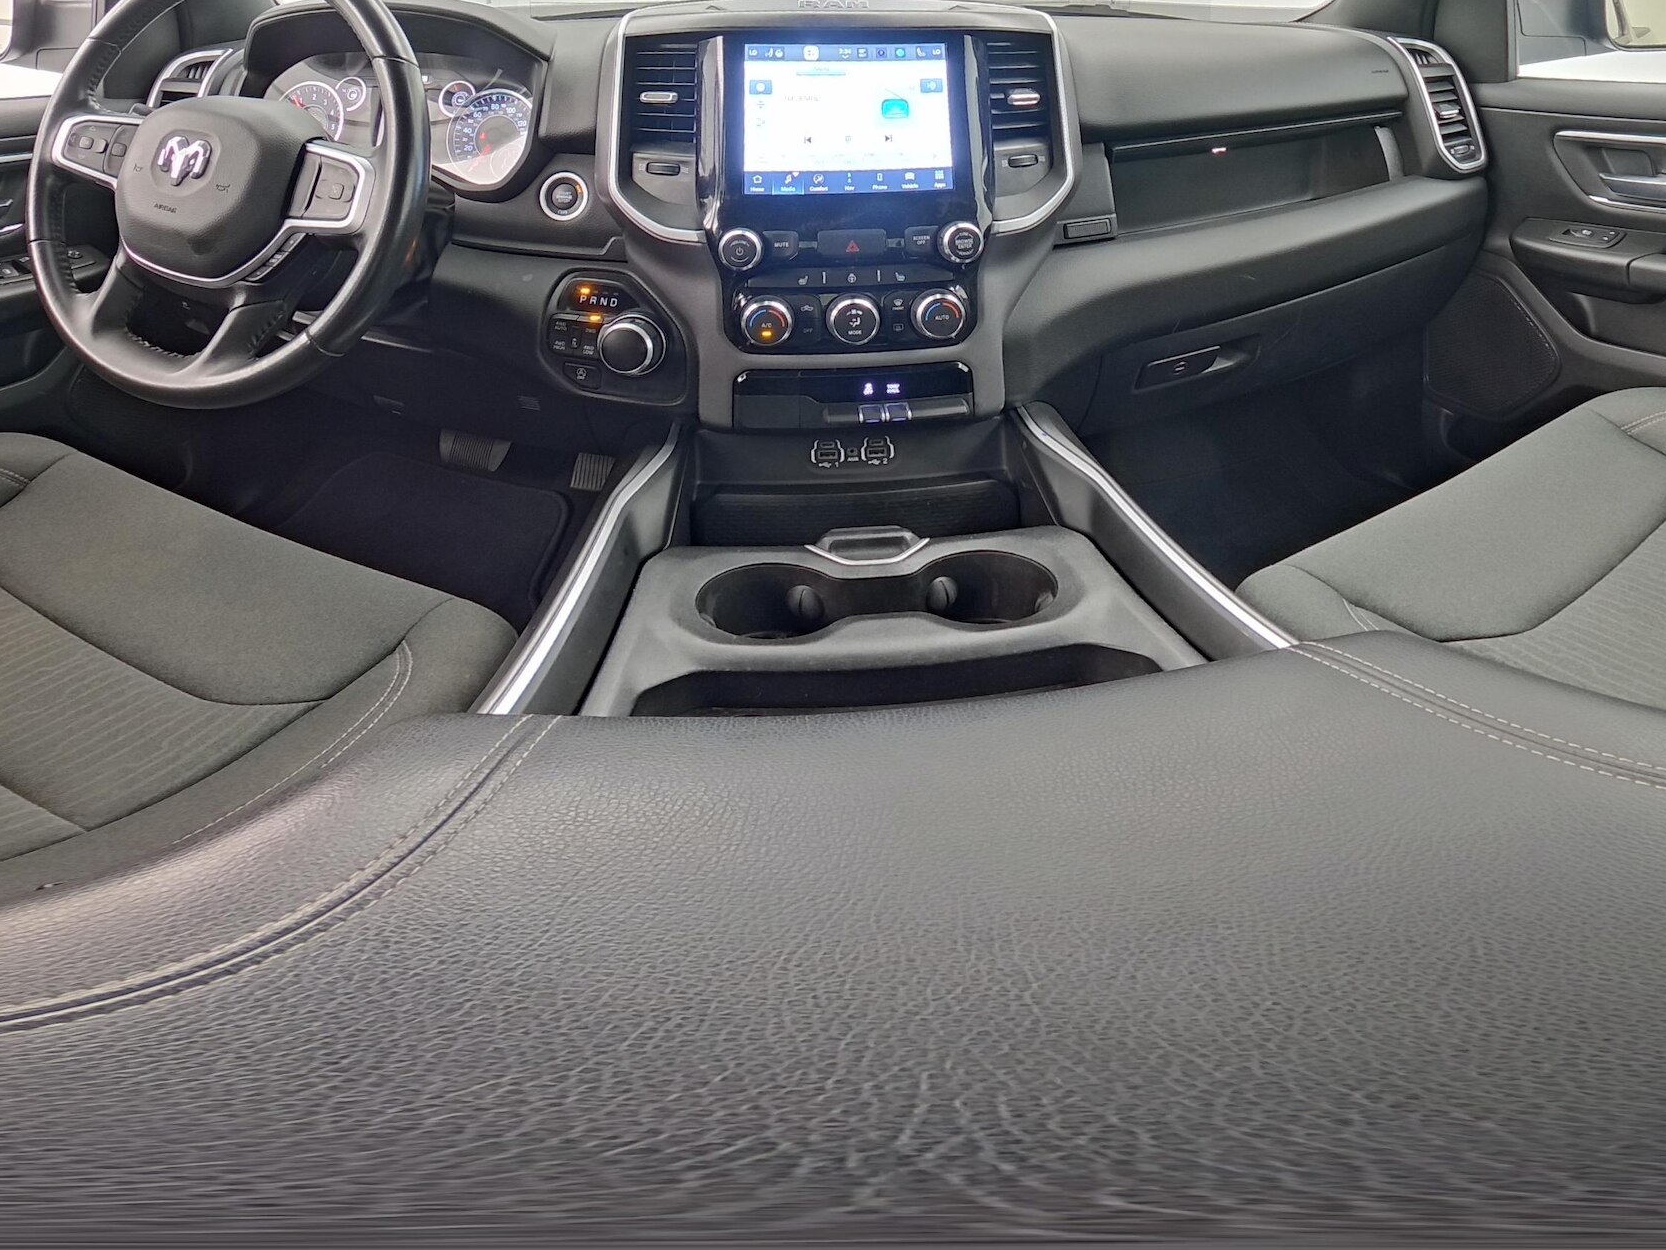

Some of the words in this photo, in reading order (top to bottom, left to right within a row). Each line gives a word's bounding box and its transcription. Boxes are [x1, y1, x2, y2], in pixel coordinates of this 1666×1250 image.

[797, 0, 869, 9] RAM
[579, 295, 587, 303] P
[589, 296, 597, 304] R
[600, 297, 608, 306] N
[609, 298, 618, 307] D
